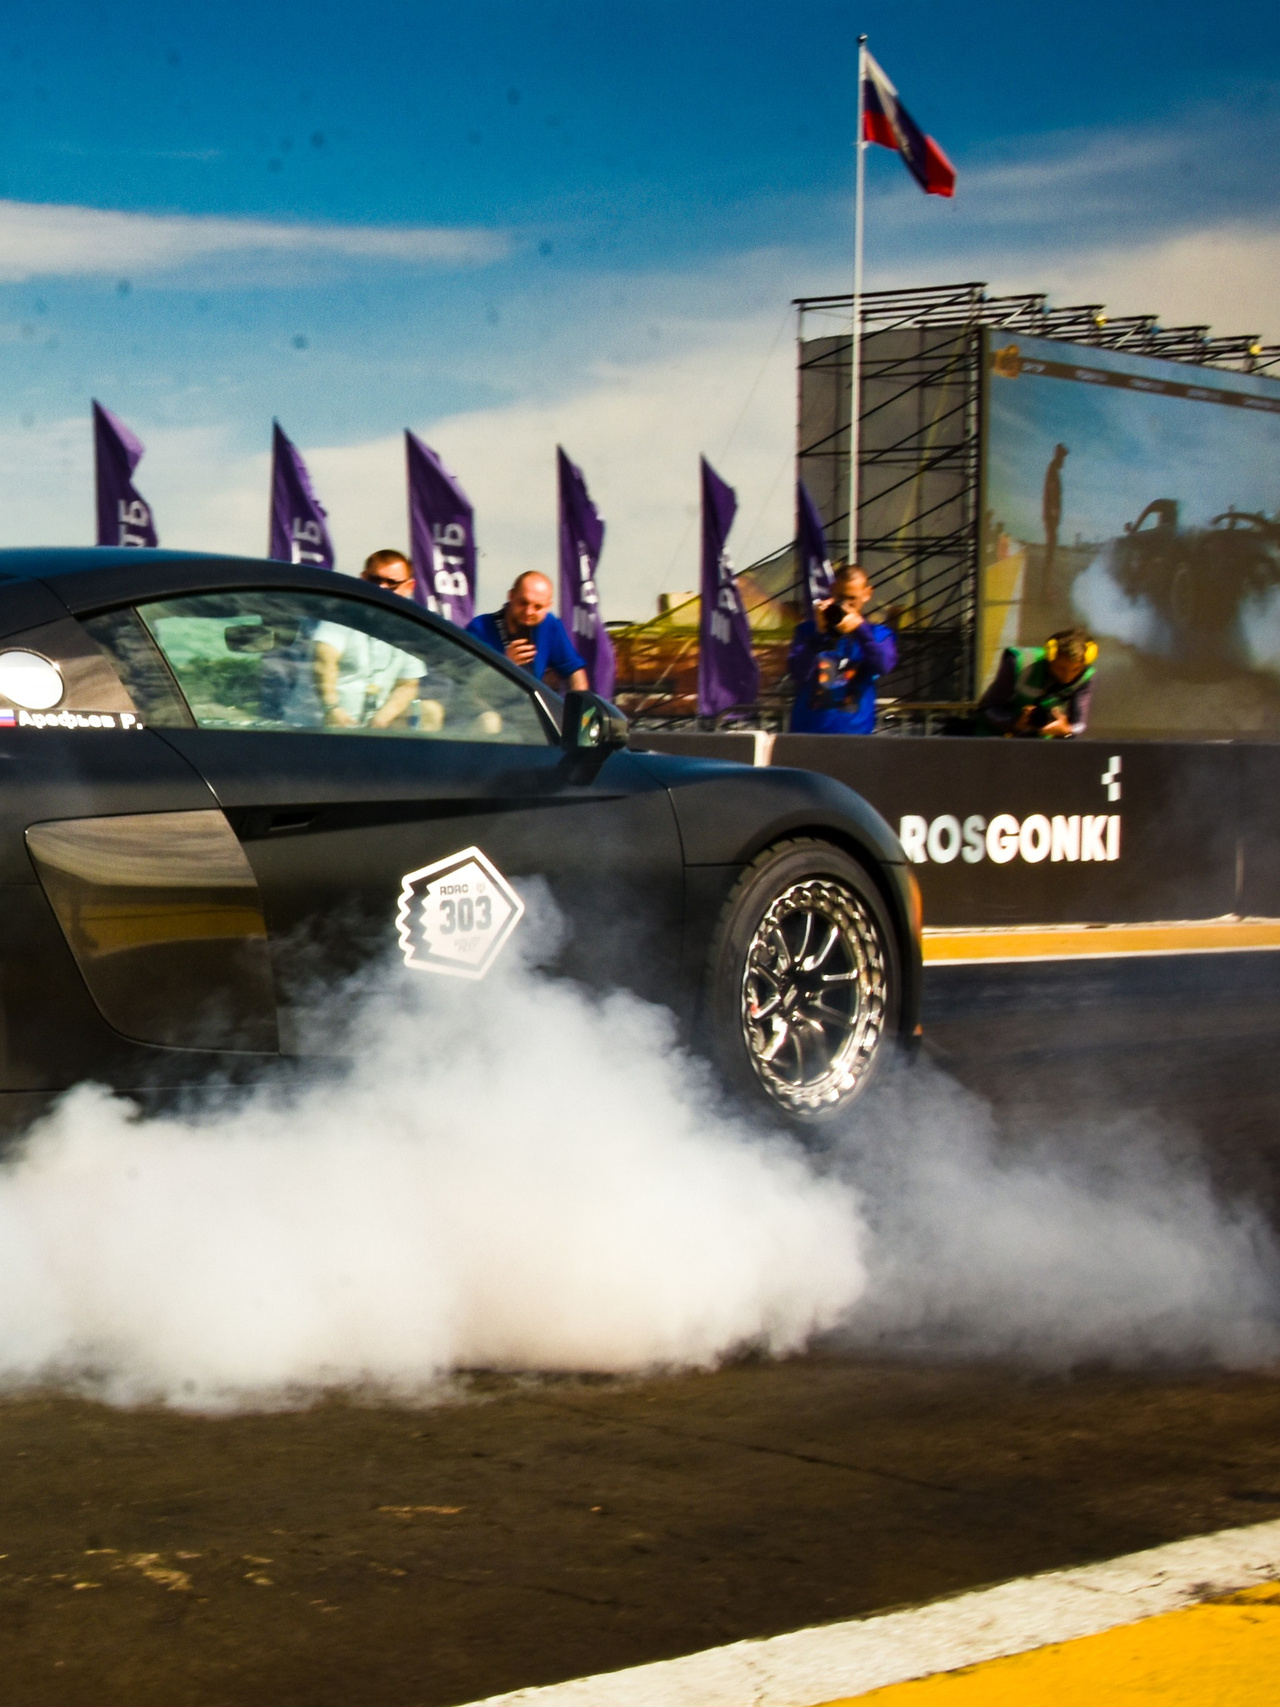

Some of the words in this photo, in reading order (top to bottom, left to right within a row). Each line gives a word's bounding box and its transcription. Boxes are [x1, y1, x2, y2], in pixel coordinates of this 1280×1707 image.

[433, 523, 468, 596] ВТБ
[900, 814, 1120, 864] ROSGONKI
[440, 884, 469, 895] RDRC
[440, 895, 492, 935] 303
